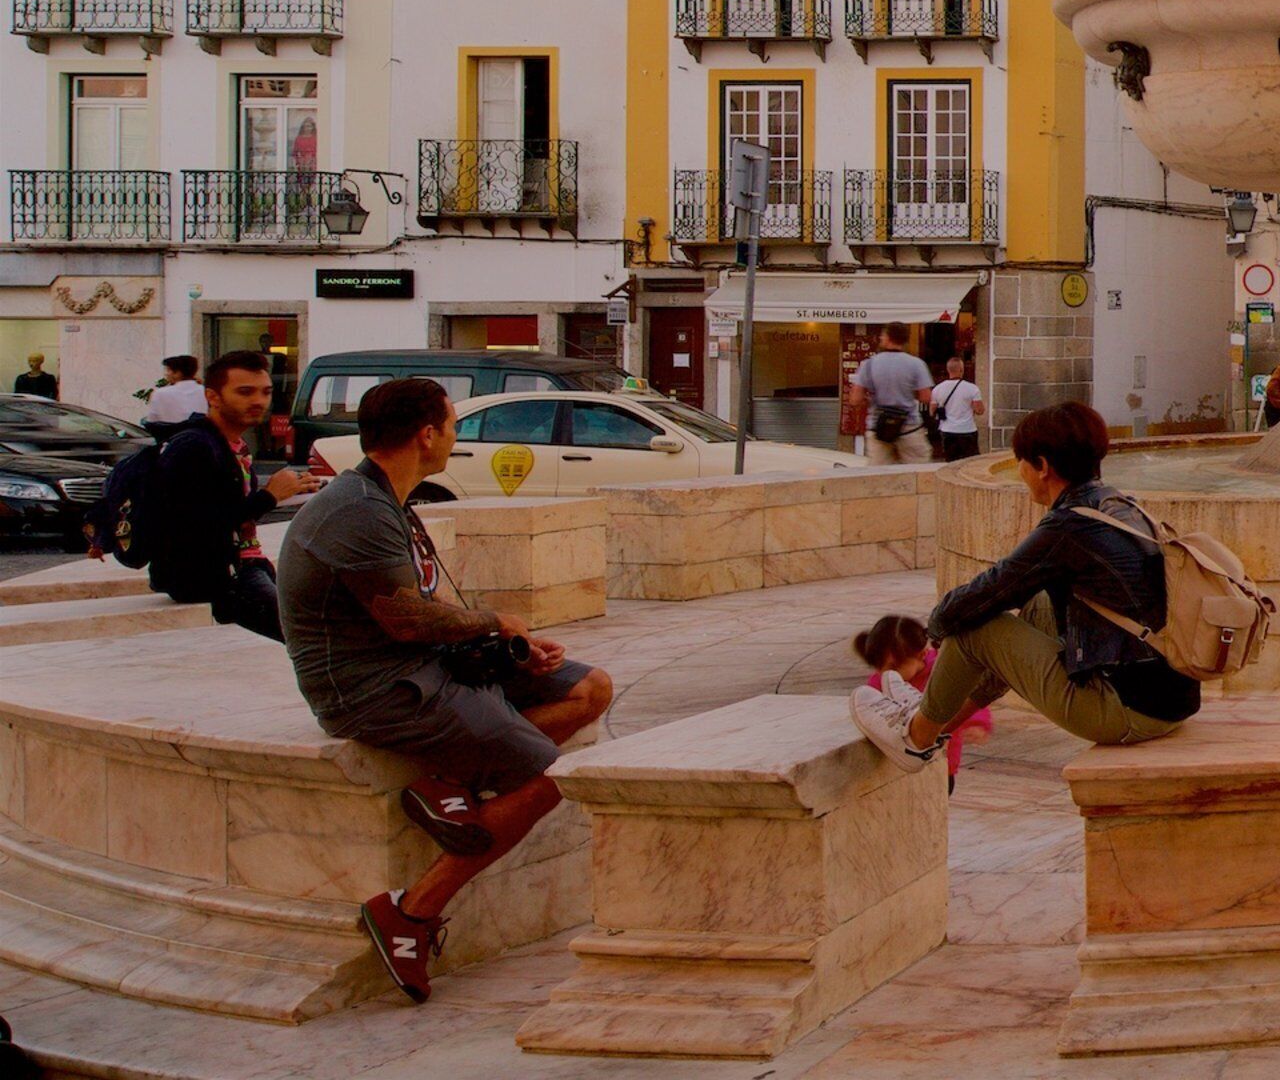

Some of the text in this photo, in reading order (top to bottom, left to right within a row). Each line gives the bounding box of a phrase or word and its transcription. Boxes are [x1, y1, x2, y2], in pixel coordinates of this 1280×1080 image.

[322, 277, 402, 285] SANDRO FERRONE
[796, 310, 868, 319] ST. HUMBERTO
[772, 330, 820, 342] Cafetaria
[440, 796, 468, 814] N
[392, 936, 418, 959] N
